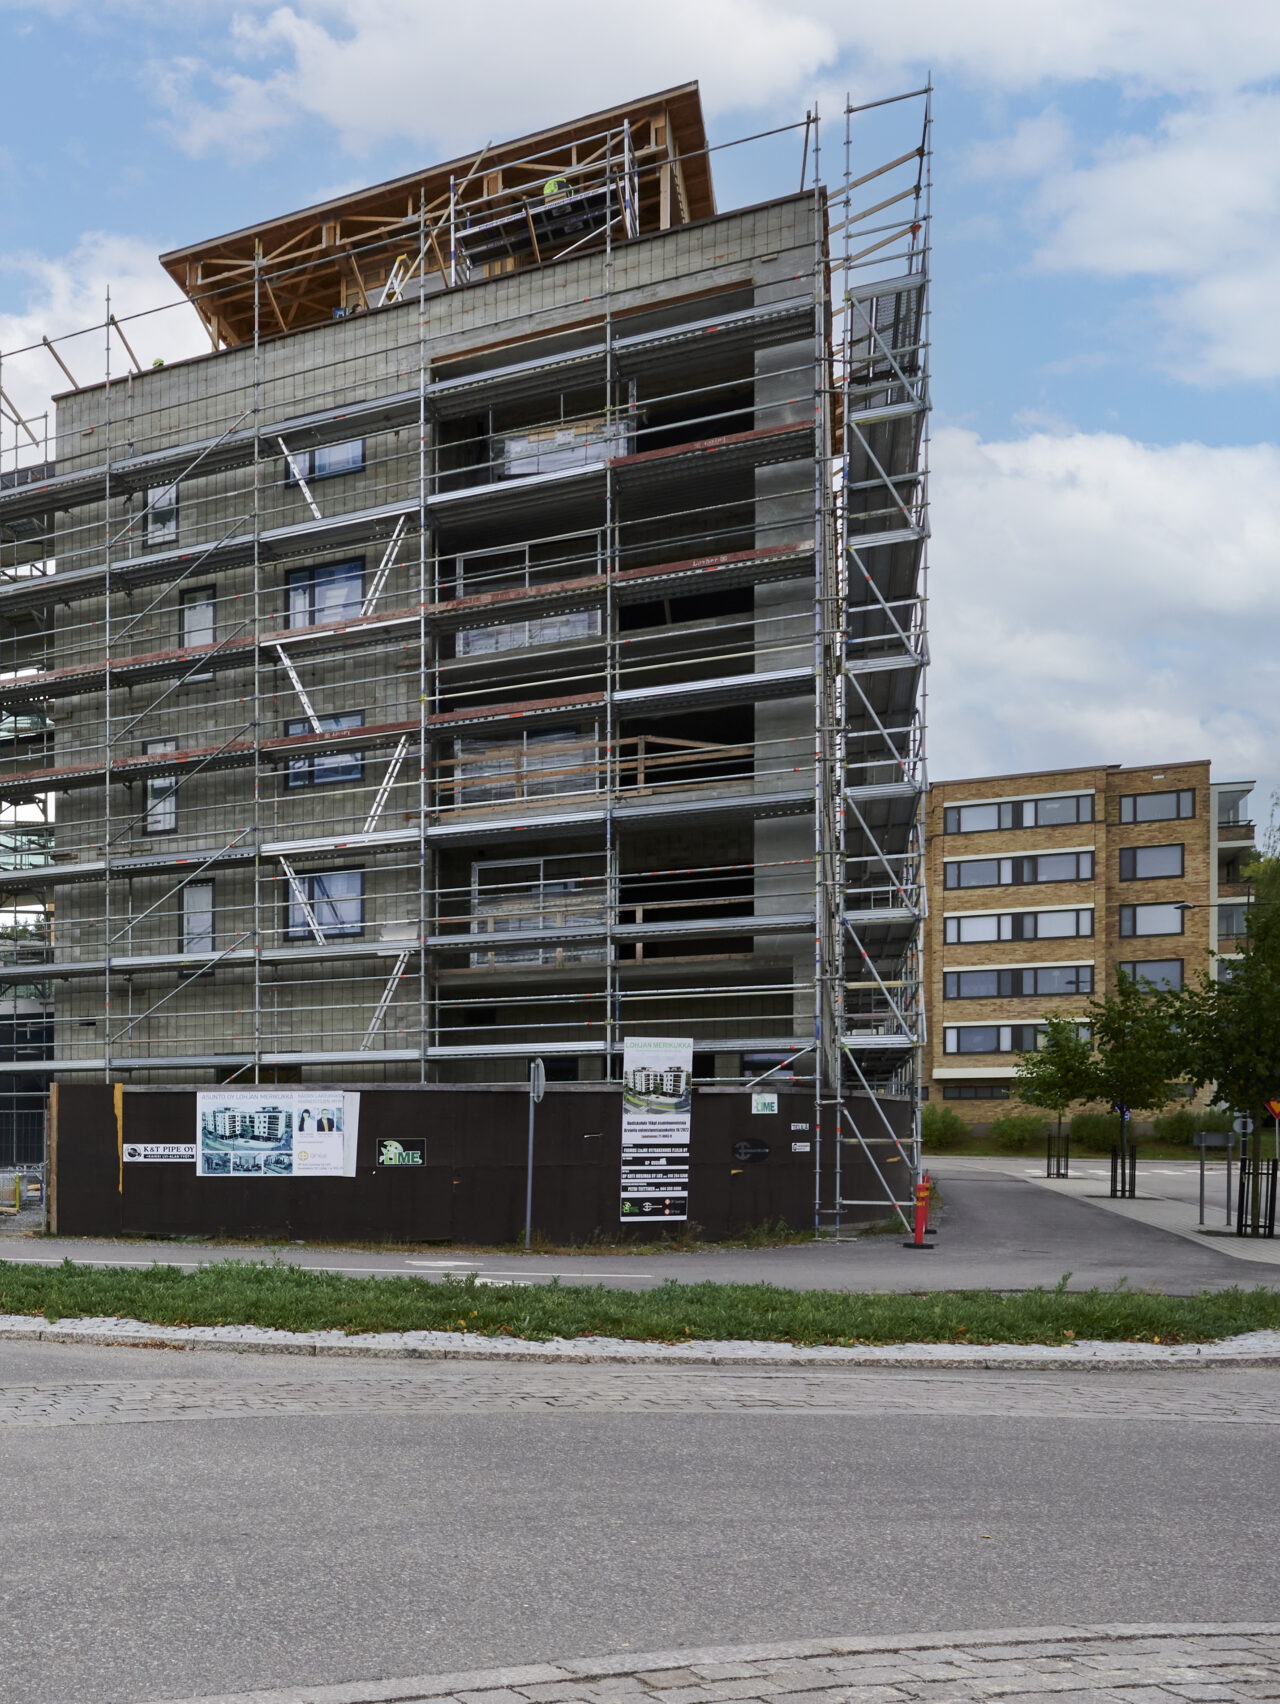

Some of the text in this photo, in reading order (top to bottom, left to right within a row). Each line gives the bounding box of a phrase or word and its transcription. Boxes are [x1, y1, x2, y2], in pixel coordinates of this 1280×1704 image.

[626, 1041, 692, 1049] LOHJAN MERIKUKKA
[756, 1101, 776, 1113] LIME
[384, 1150, 421, 1165] LIME
